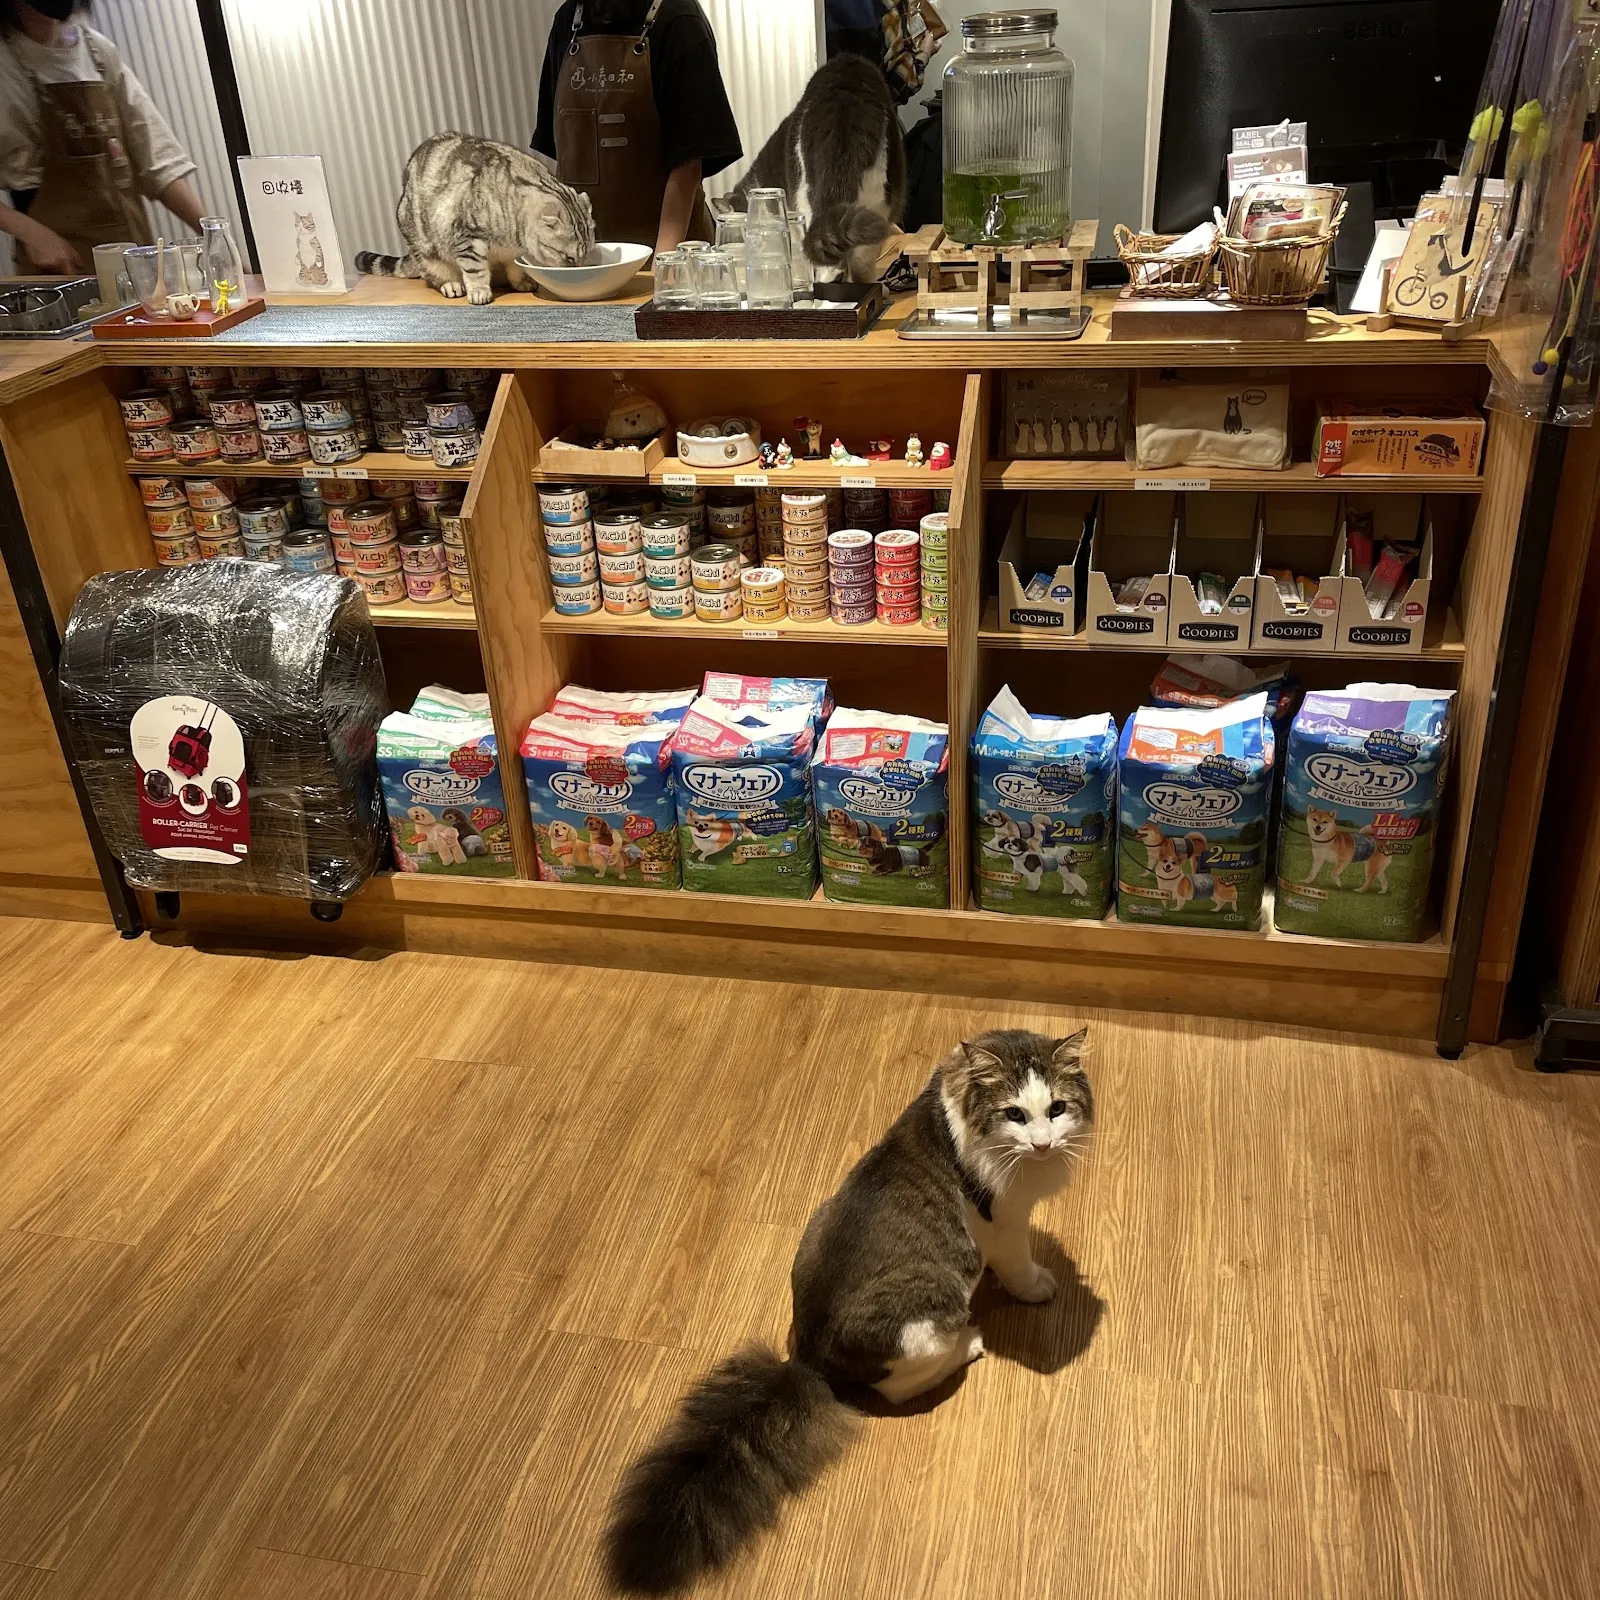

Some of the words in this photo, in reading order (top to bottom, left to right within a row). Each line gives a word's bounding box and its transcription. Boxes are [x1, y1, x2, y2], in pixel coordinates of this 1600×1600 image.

[588, 65, 634, 87] 小春日和
[1236, 131, 1261, 140] LABEL
[1388, 429, 1419, 437] ネコバス
[551, 531, 582, 542] Vi.Chi
[647, 533, 676, 544] Vi.Chi
[358, 552, 388, 562] Vi.Chi
[606, 560, 635, 571] Vi.Chi
[648, 563, 677, 574] Vi.Chi
[561, 591, 591, 601] Vi.Chi
[654, 594, 683, 606] Vi.Chi
[1012, 610, 1061, 625] GOODIES
[1100, 617, 1150, 631] GOODIES
[1181, 624, 1236, 638] GOODIES
[1265, 623, 1320, 637] GOODIES
[1352, 628, 1408, 643] GOODIES
[378, 746, 393, 757] SS
[528, 746, 538, 757] S
[975, 743, 988, 756] M
[1316, 761, 1406, 787] マナーウェア
[692, 772, 773, 791] マナーウェア
[1153, 790, 1233, 809] マナーウェア
[152, 818, 208, 829] ROLLER-CARRIER
[220, 825, 239, 833] Carrier
[894, 818, 925, 836] 2種類
[1051, 820, 1084, 838] 2種類
[1205, 846, 1241, 864] 2種類
